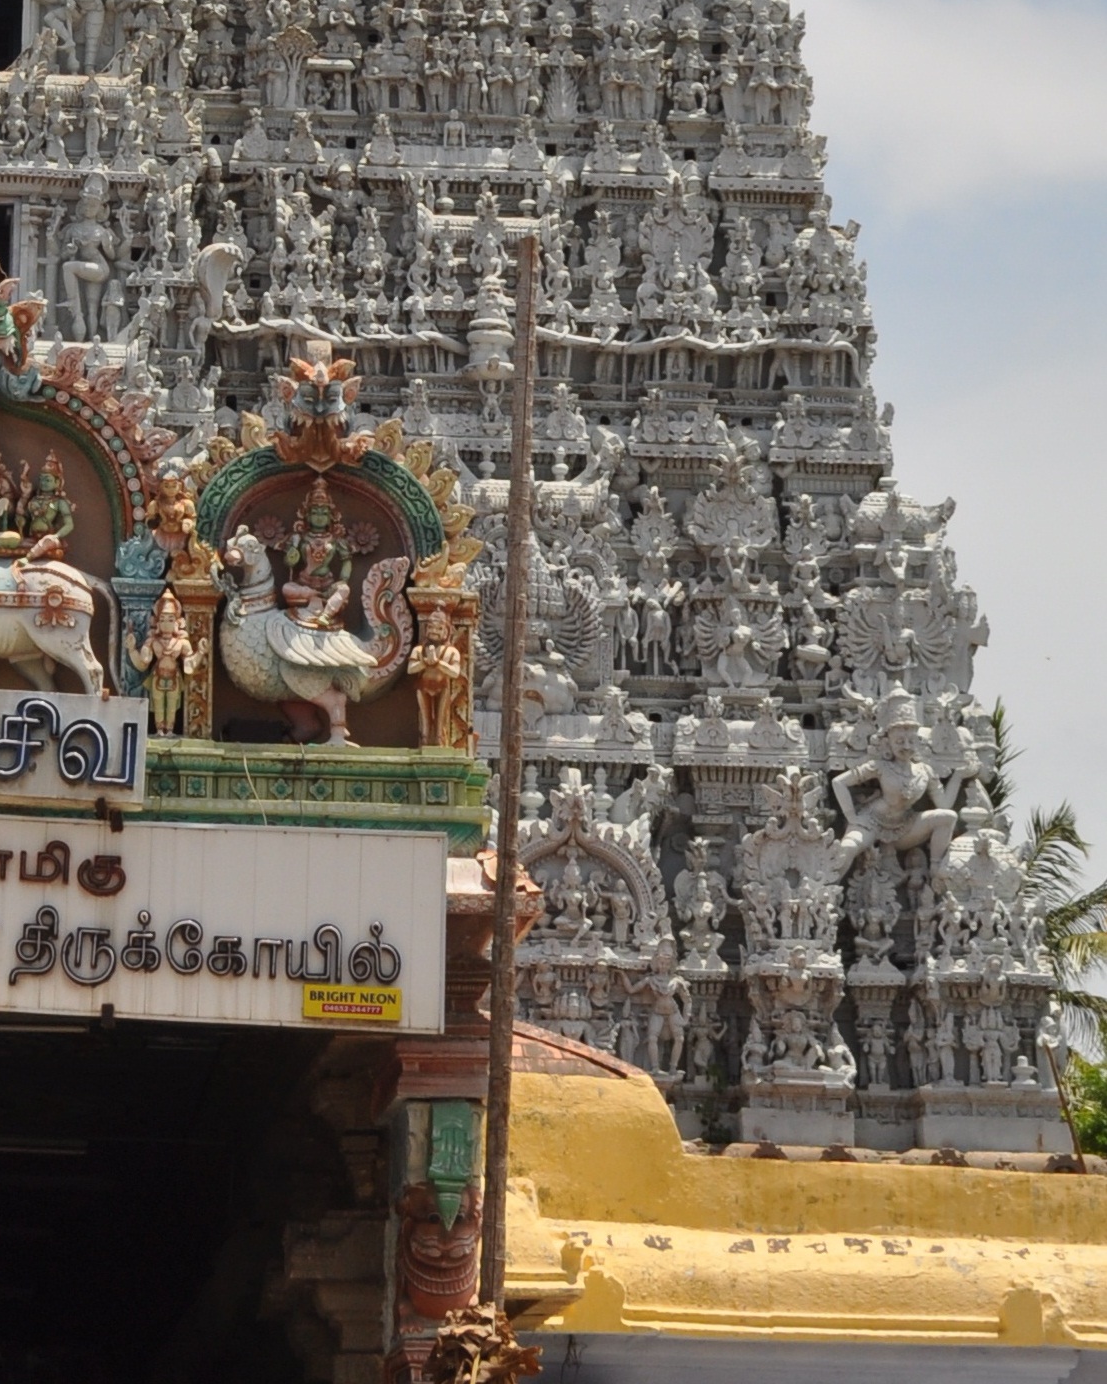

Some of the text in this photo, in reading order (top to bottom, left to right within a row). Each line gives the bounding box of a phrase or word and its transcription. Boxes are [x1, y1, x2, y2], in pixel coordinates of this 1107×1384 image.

[9, 905, 402, 986] திருக்கோயில்
[309, 990, 397, 1005] BRIGHT NEON
